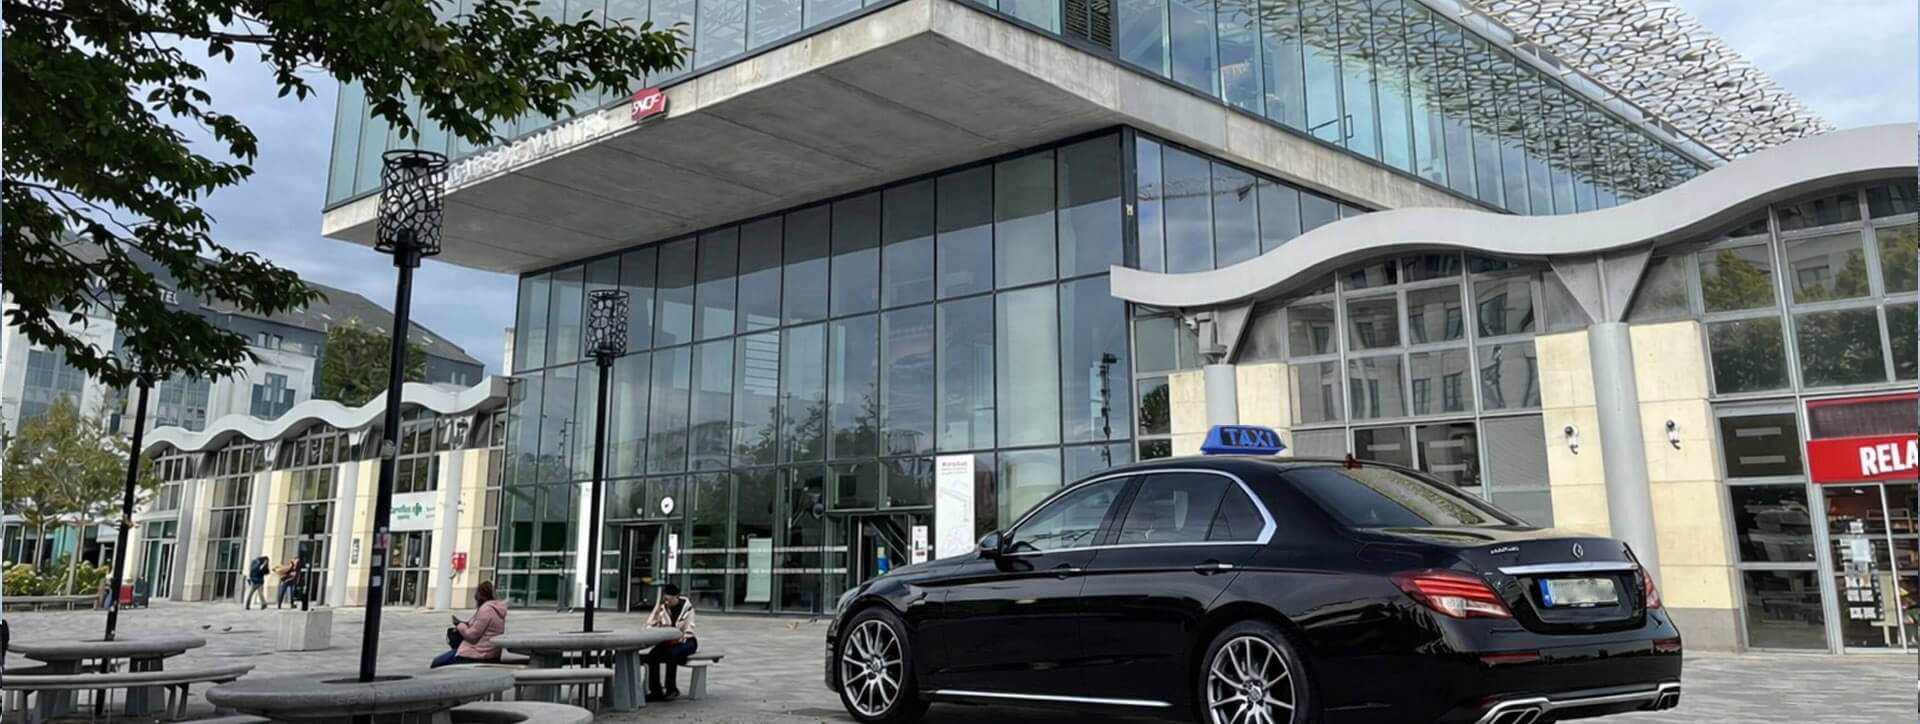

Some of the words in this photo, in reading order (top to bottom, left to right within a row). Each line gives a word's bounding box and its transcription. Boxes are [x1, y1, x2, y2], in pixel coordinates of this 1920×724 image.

[632, 93, 661, 116] SNCF
[157, 288, 179, 305] TEL
[1224, 428, 1275, 448] TAXI
[1859, 439, 1918, 475] RELA
